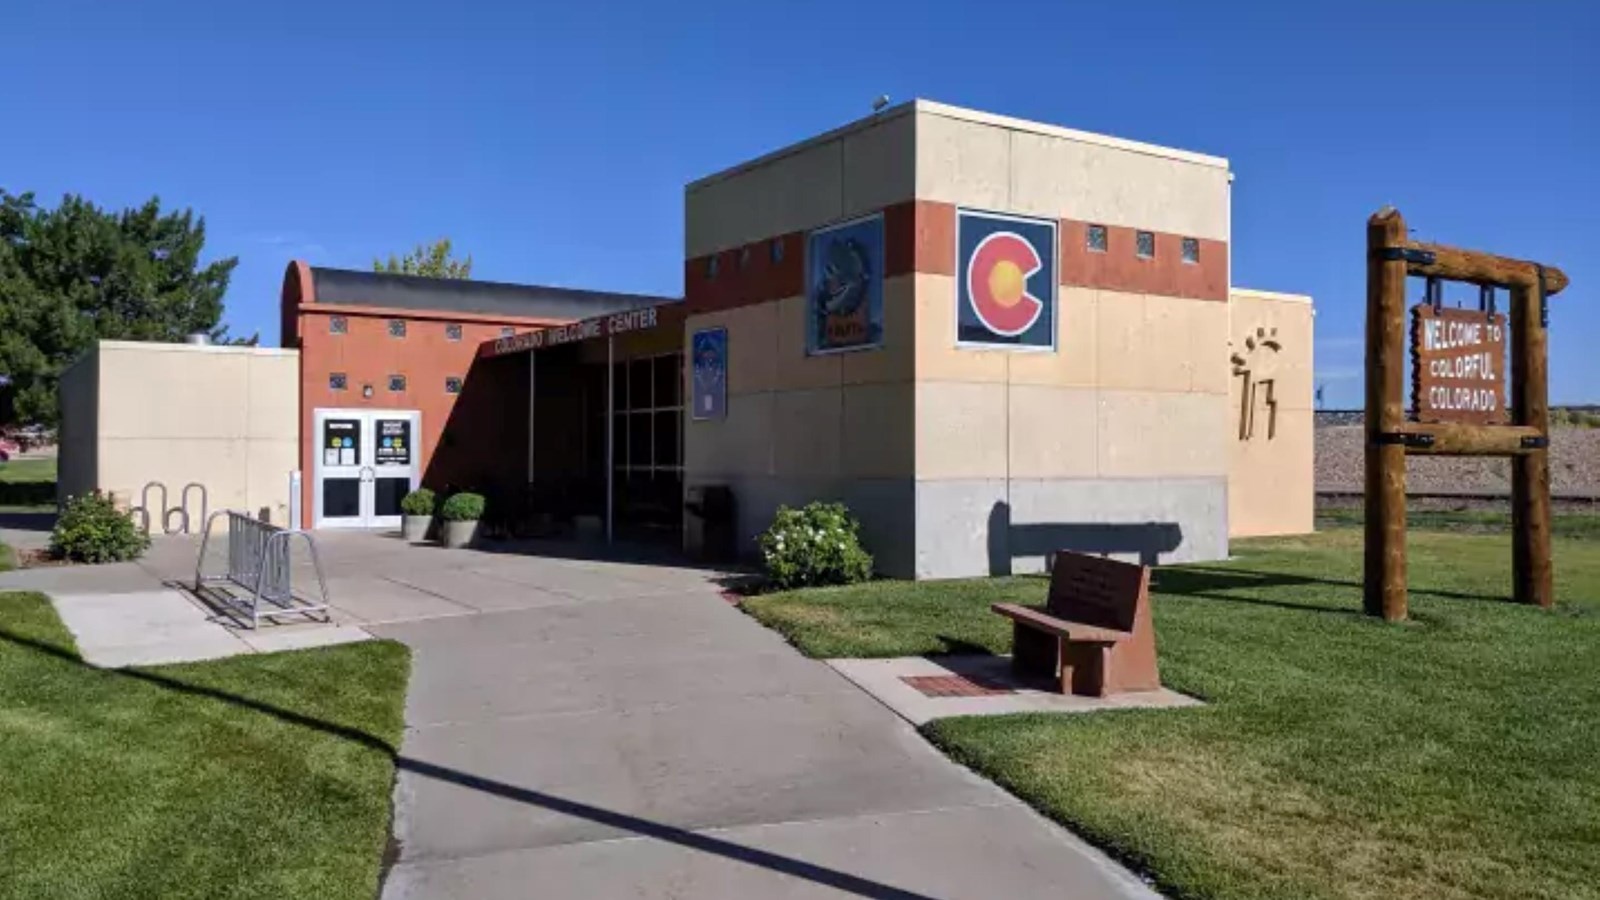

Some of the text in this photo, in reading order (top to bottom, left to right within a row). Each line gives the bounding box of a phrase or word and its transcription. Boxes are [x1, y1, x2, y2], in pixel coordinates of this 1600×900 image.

[494, 308, 657, 354] COLORADO WELCOME CENTER
[1424, 318, 1502, 351] WELCOME TO
[1430, 352, 1495, 380] COLORFUL
[1430, 385, 1497, 411] COLORADO
